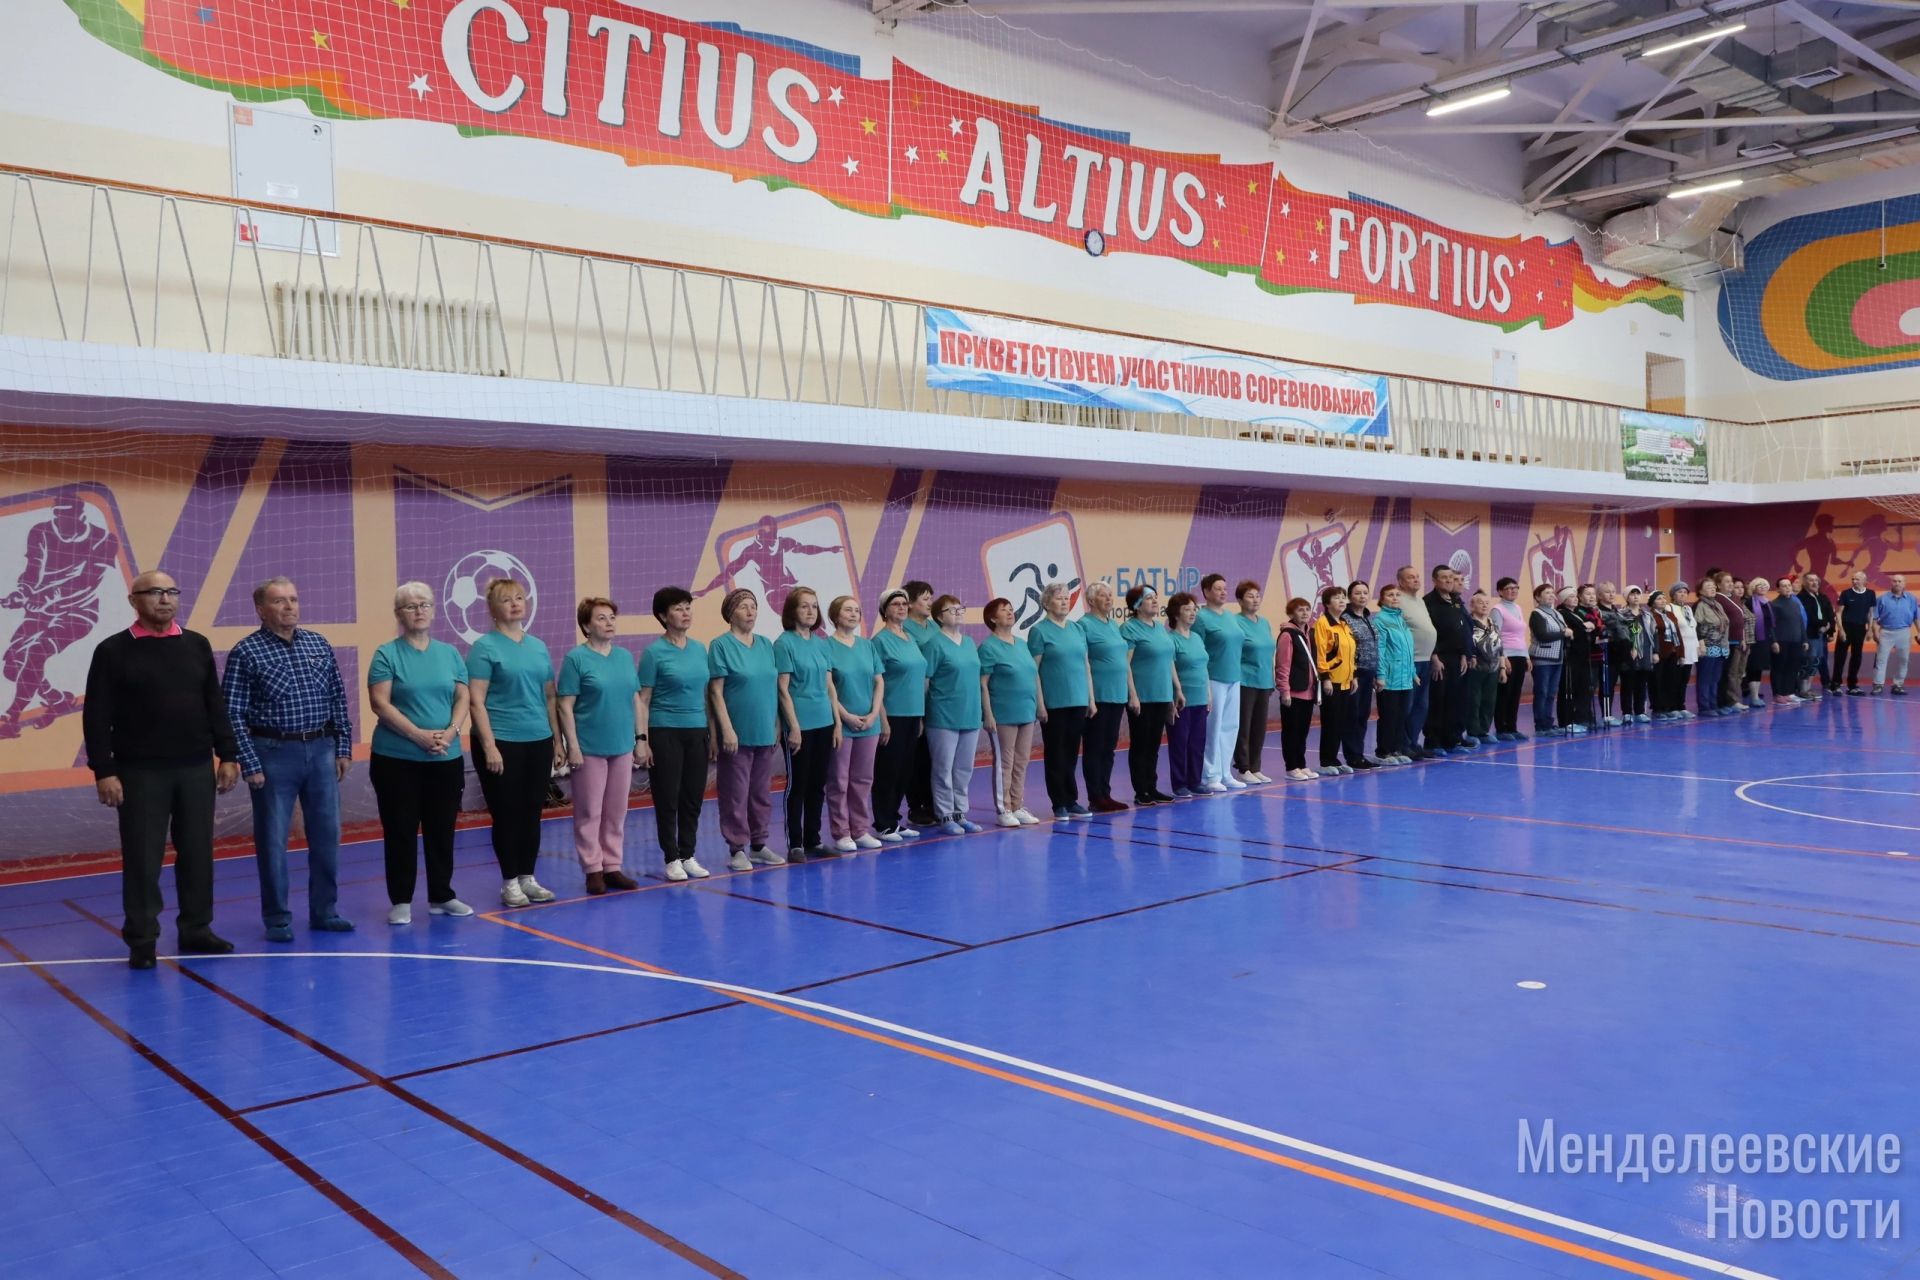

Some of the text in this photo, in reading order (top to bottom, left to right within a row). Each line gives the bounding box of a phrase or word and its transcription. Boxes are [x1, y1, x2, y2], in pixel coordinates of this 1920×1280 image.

[441, 0, 1516, 314] CITIUS ALTIUS FORTIUS
[939, 329, 1376, 417] ПРИВЕТСТВУЕМ УЧАСТНИКОВ СОРЕВНОВАНИЯ!
